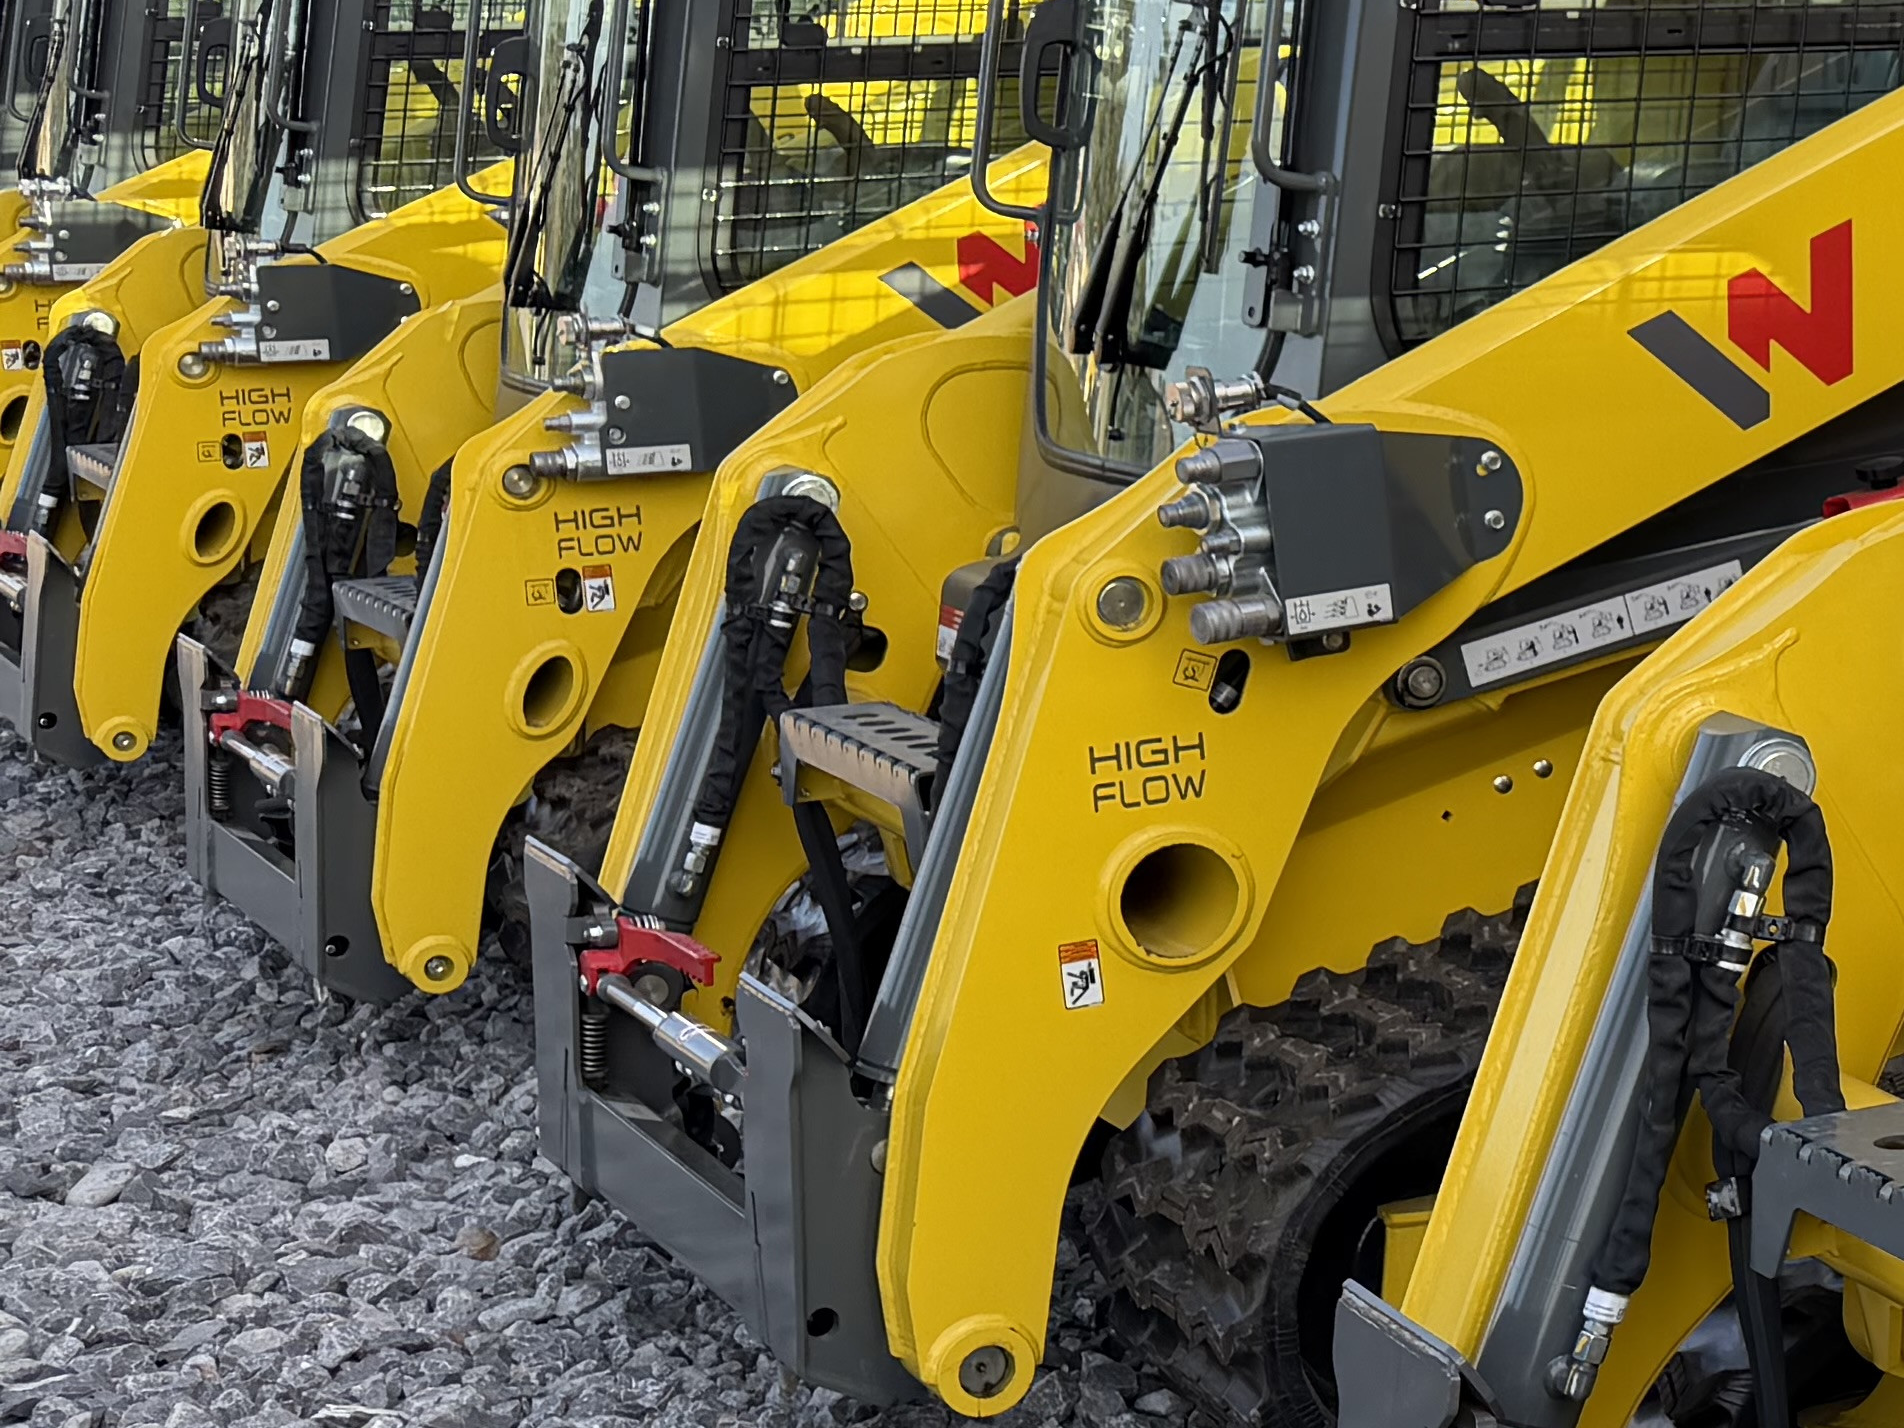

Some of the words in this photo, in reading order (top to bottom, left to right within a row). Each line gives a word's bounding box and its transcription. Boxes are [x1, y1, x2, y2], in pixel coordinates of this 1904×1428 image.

[219, 386, 292, 407] HIGH
[222, 407, 292, 428] FLOW
[553, 504, 642, 533] HIGH
[557, 531, 643, 560] FLOW
[1088, 731, 1206, 775] HIGH
[1092, 769, 1207, 814] FLOW
